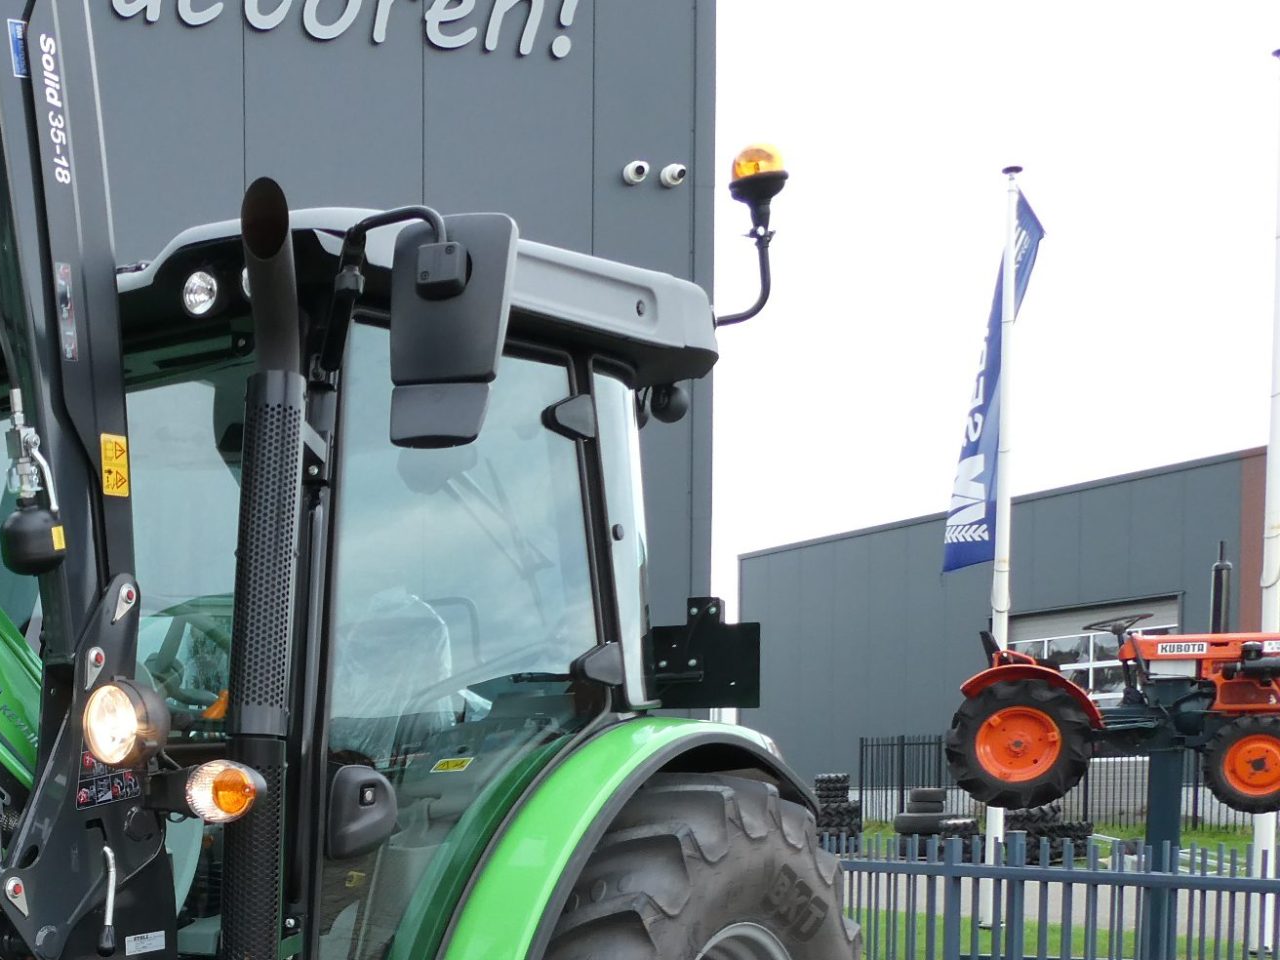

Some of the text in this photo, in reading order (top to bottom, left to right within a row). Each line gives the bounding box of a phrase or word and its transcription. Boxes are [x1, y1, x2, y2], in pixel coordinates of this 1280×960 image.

[40, 33, 70, 185] Solid 35-18
[1160, 643, 1205, 654] KUBOTA
